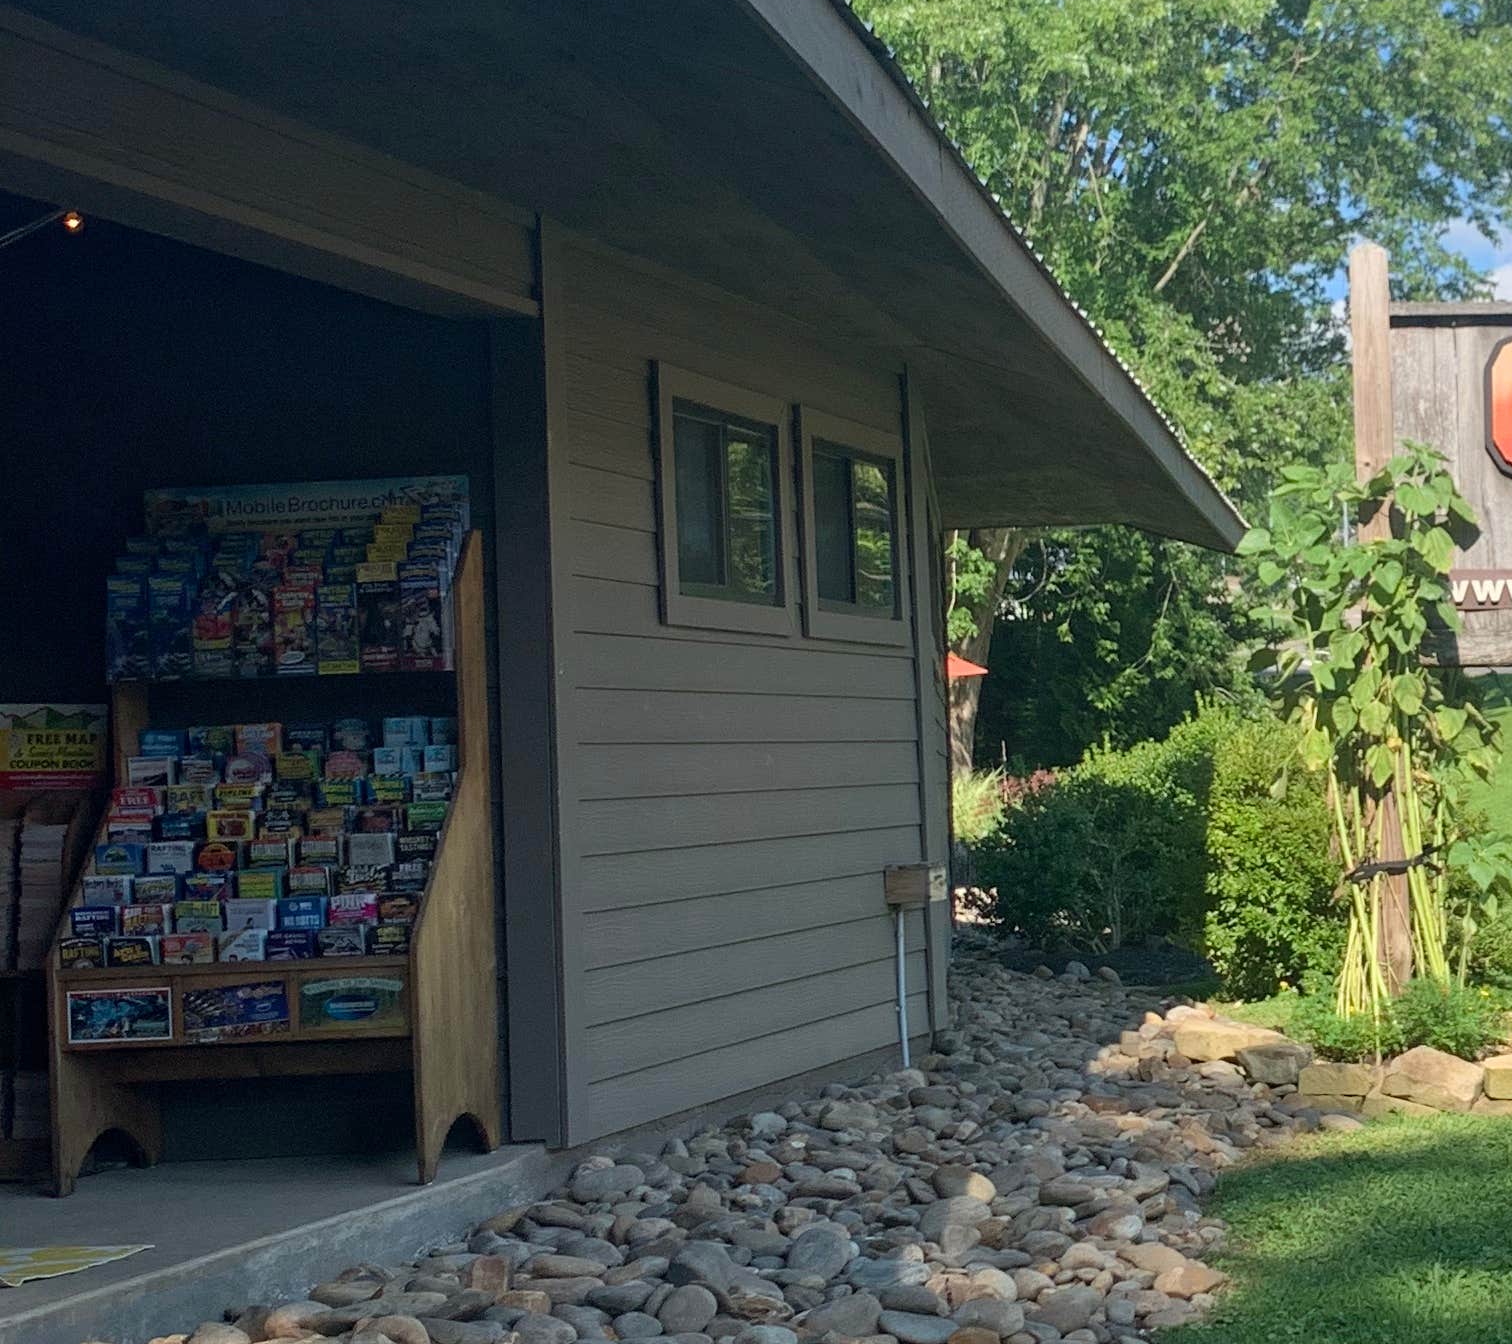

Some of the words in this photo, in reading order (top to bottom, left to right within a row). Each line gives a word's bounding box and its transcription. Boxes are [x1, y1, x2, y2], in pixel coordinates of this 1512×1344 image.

[26, 733, 62, 745] FREE
[65, 733, 98, 745] MAP
[9, 759, 60, 769] COUPON
[62, 759, 97, 769] BOOK
